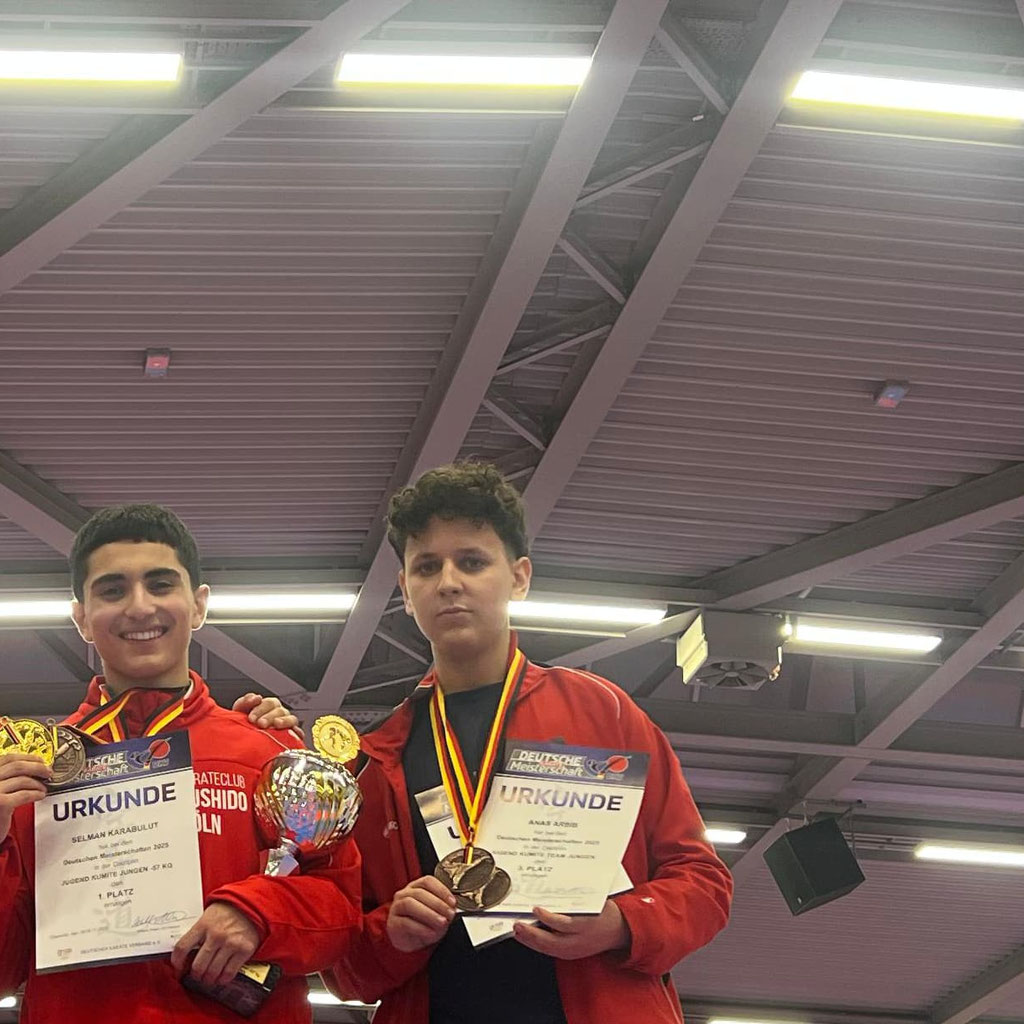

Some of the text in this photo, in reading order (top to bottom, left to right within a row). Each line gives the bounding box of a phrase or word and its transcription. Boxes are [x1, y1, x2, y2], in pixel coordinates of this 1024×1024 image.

[87, 751, 126, 768] TSCHE
[519, 750, 583, 766] DEUTSCHE
[510, 761, 584, 777] Meisterschaft
[194, 771, 246, 789] RATECLUB
[53, 782, 176, 822] URKUNDE
[195, 788, 248, 812] USHIDO
[500, 785, 624, 811] URKUNDE
[196, 810, 222, 835] ÖLN
[528, 819, 551, 827] ANAS
[71, 822, 159, 844] SELMAN KARABULUT
[63, 842, 170, 866] Deutschen Meisterschaften 2025
[61, 876, 90, 886] JUGEND
[91, 871, 118, 881] KUMITE
[119, 866, 149, 876] JUNGEN
[106, 888, 134, 899] PLATZ
